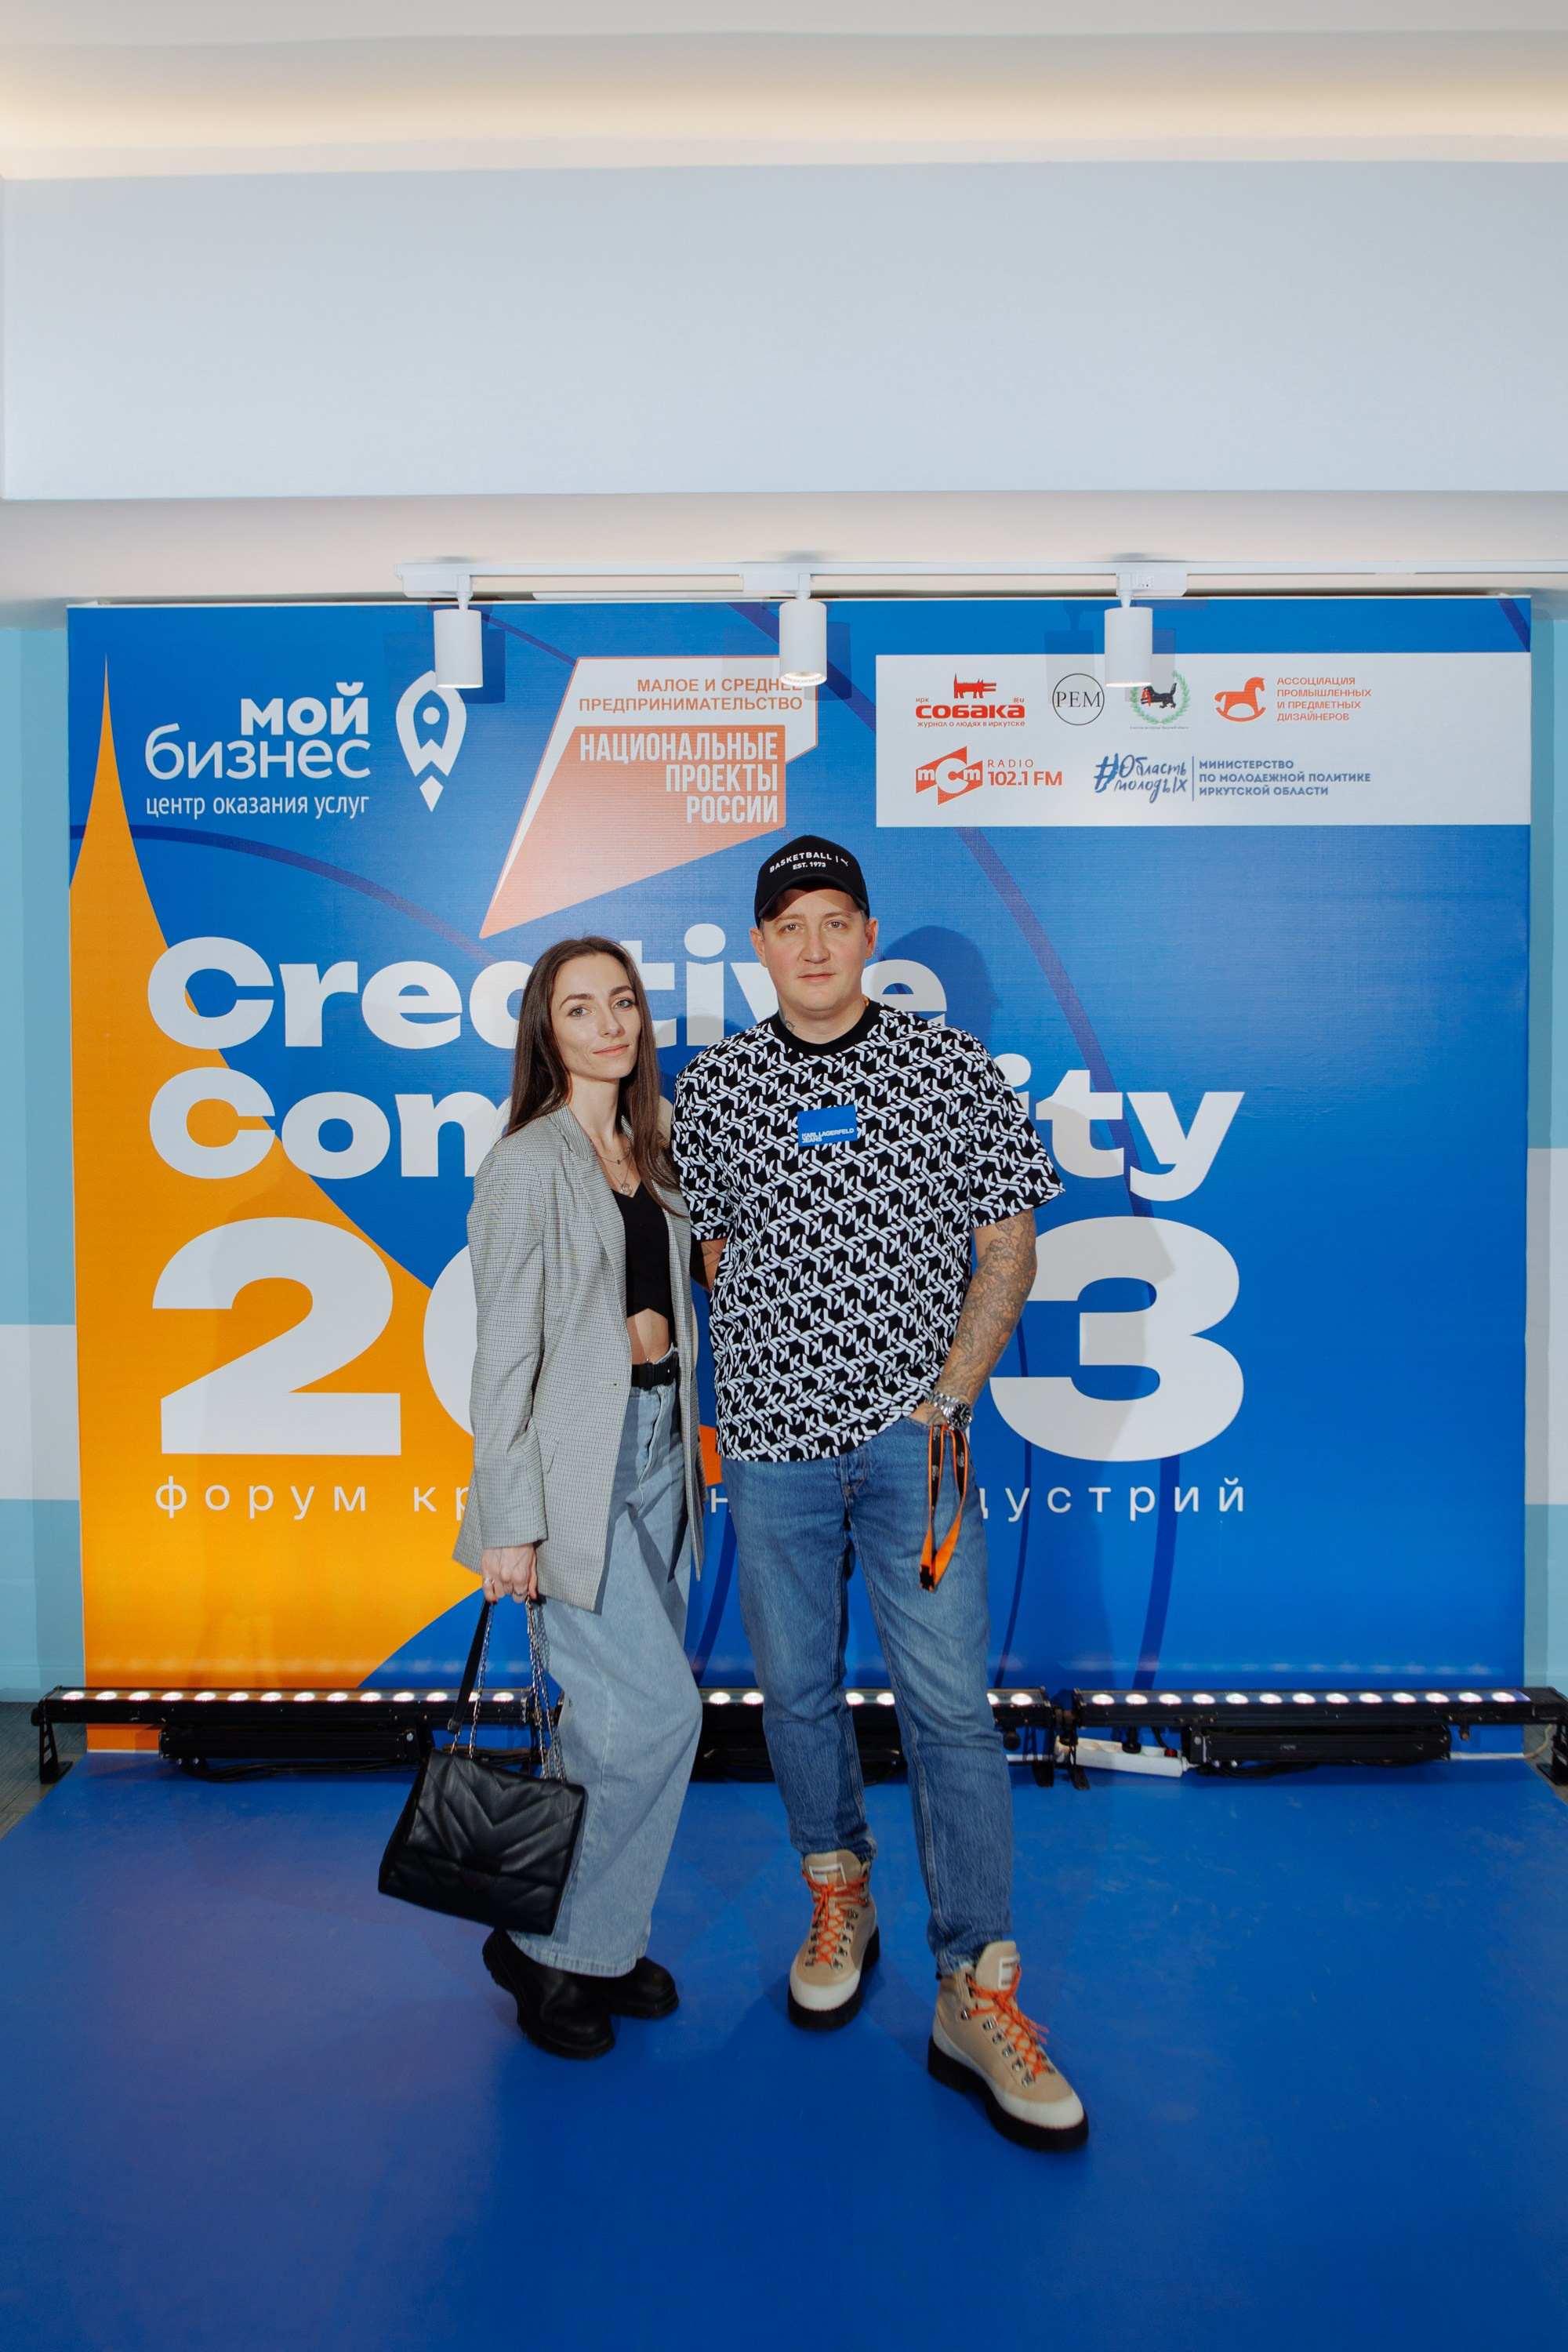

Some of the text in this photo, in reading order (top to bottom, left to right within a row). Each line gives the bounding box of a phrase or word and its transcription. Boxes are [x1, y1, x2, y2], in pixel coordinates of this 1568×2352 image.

[637, 679, 699, 692] МАЛОЕ
[705, 679, 716, 691] И
[1277, 677, 1355, 687] АССОЦИАЦИЯ
[1277, 688, 1371, 697] ПРОМЫШЛЕННЫХ
[241, 681, 368, 735] мой
[579, 696, 802, 713] ПРЕДПРИНИМАТЕЛЬСТВО
[1288, 700, 1361, 710] ПРЕДМЕТНЫХ
[1277, 710, 1349, 722] ДИЗАЙНЕРОВ
[145, 723, 371, 780] бизнес
[580, 732, 778, 764] НАЦИОНАЛЬНЫЕ
[988, 759, 1033, 768] RADIO
[1200, 760, 1294, 770] МИНИСТЕРСТВО
[666, 764, 778, 792] ПРОЕКТЫ
[988, 771, 1062, 786] 102.1 FM
[1200, 771, 1371, 783] ПО МОЛОДЕЖНОЙ ПОЛИТИКЕ
[1200, 784, 1328, 796] ИРКУТСКОЙ ОБЛАСТИ
[147, 796, 369, 819] центр оказания услуг
[687, 795, 778, 823] РОССИИ
[770, 851, 832, 873] BASKETBALL
[818, 1128, 855, 1137] LAGERFELD
[156, 1475, 366, 1520] форум
[978, 1477, 1244, 1522] устрий
